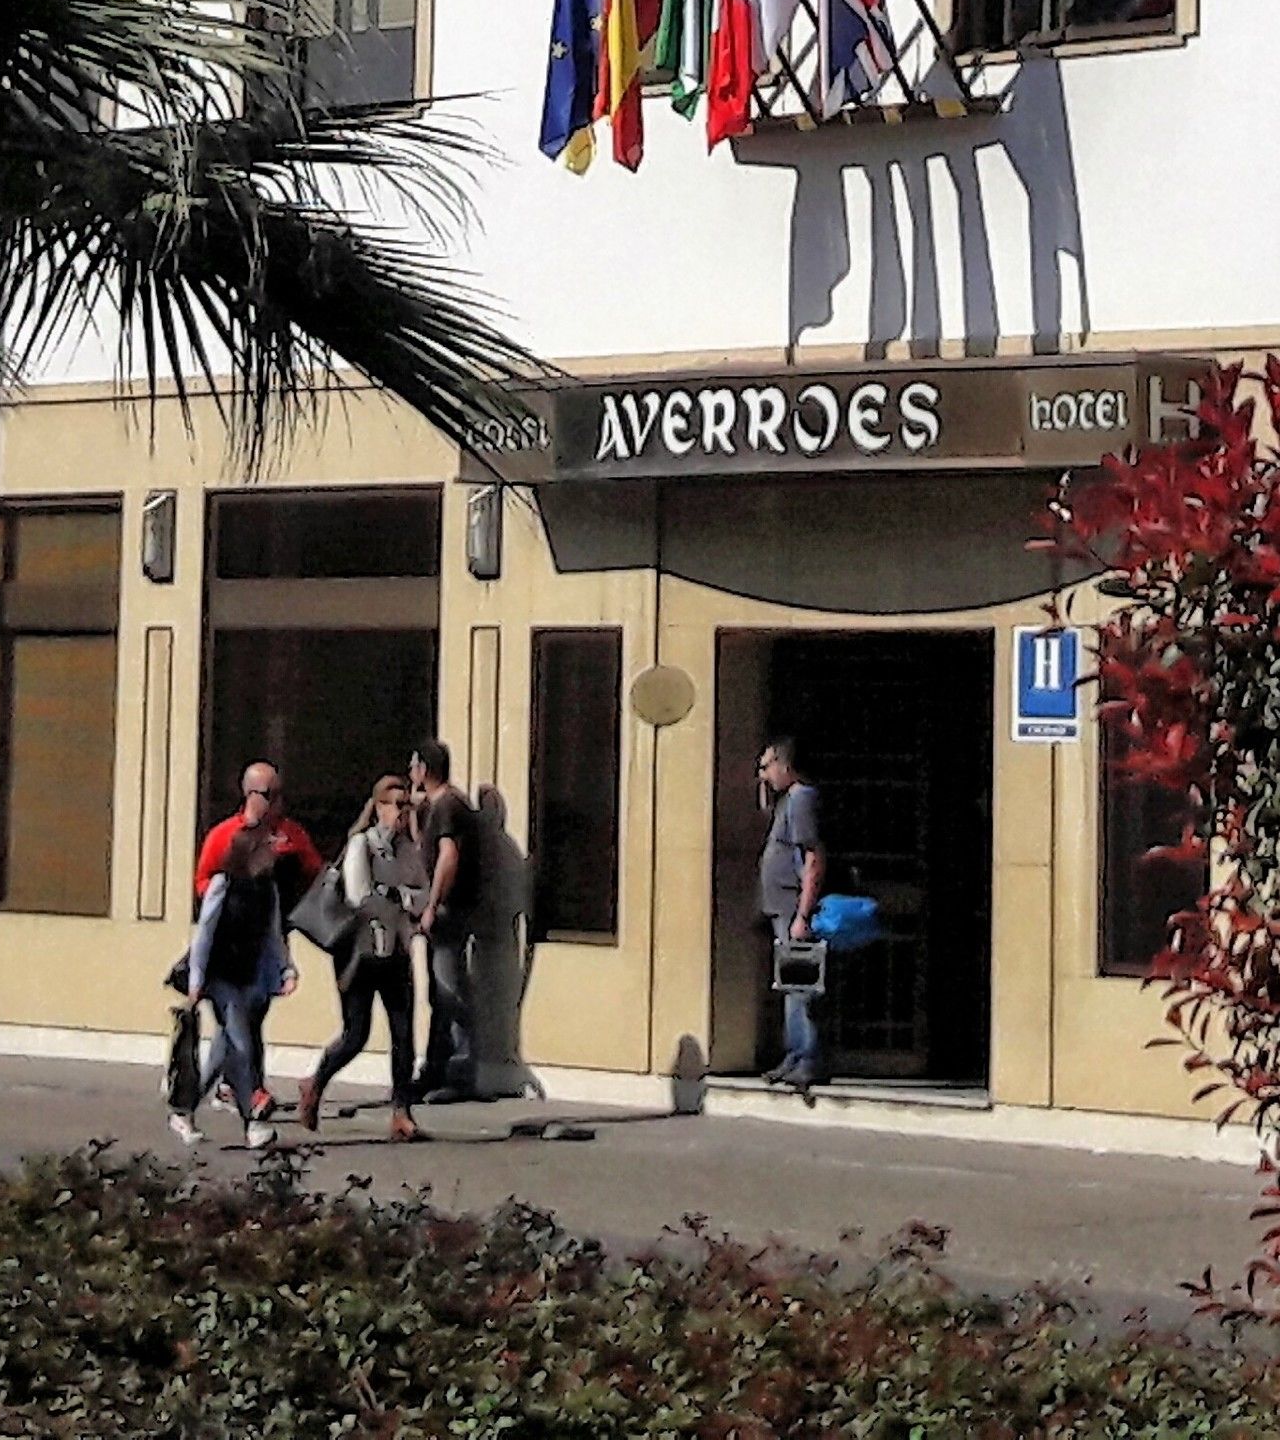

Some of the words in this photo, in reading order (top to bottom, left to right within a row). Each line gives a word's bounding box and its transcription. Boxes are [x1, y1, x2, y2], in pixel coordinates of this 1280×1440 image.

[595, 382, 942, 460] AVERROES
[1149, 375, 1201, 443] H
[1033, 637, 1061, 690] H
